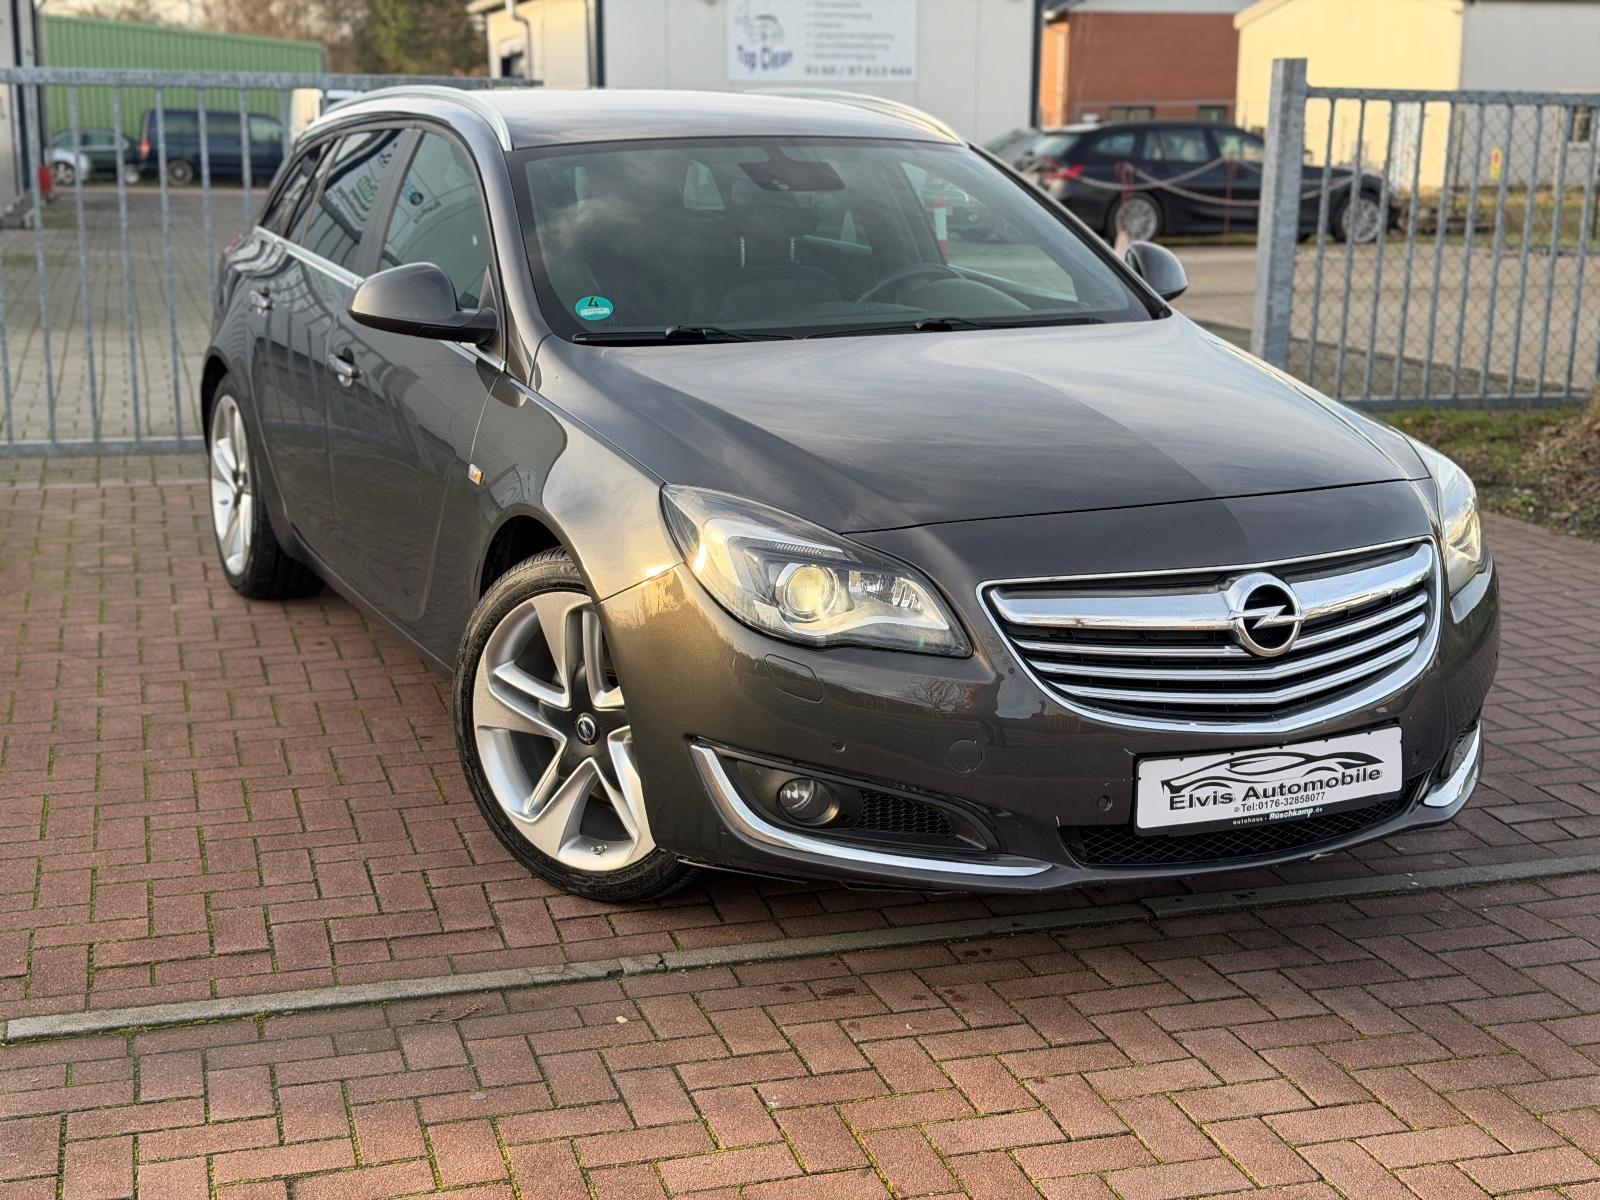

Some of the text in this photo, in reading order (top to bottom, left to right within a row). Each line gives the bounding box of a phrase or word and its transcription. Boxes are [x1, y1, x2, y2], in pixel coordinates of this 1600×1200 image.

[588, 297, 599, 308] 4
[1169, 766, 1381, 811] Elvis Automobile
[1232, 816, 1263, 825] autohaus
